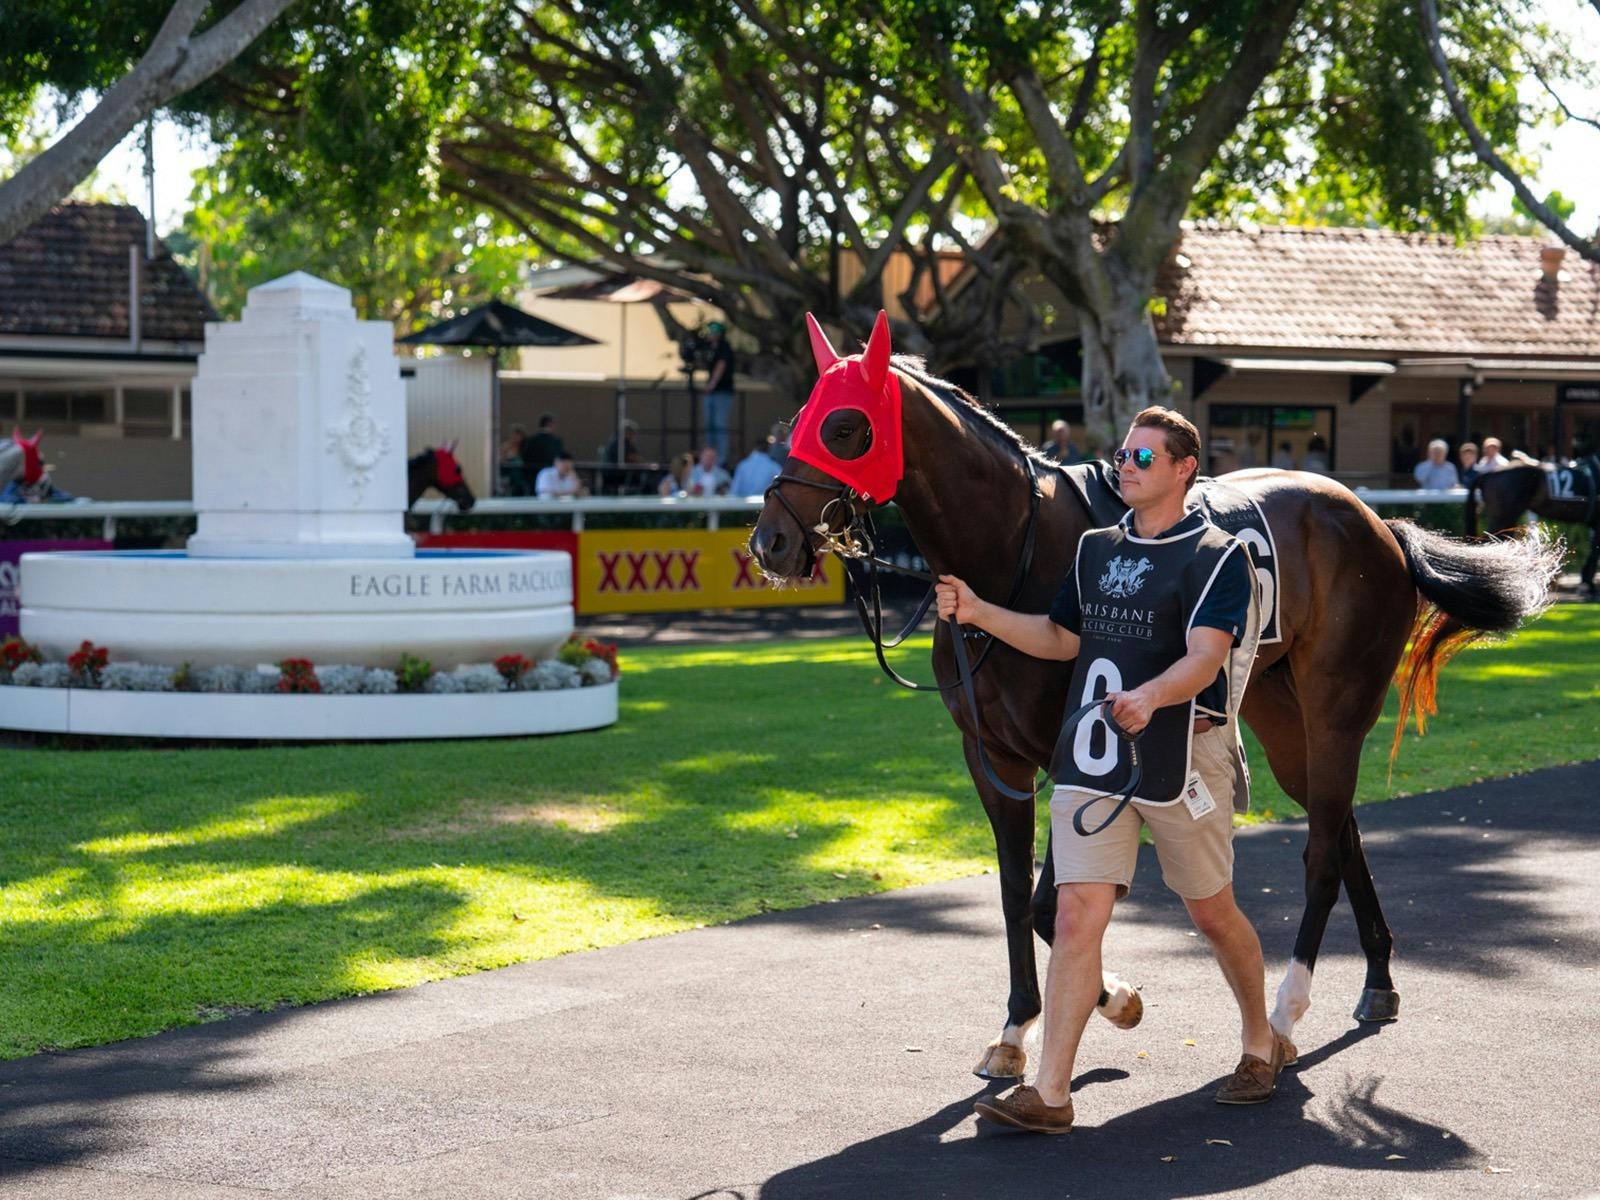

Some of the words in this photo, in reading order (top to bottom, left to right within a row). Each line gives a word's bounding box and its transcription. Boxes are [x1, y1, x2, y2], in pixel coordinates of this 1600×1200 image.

[1550, 470, 1574, 497] 12
[351, 574, 431, 596] EAGLE
[443, 573, 501, 596] FARM
[598, 551, 700, 591] XXXX
[733, 551, 829, 588] XX
[1236, 528, 1274, 632] 6
[1082, 621, 1115, 632] ACING
[1119, 625, 1153, 638] CLUB
